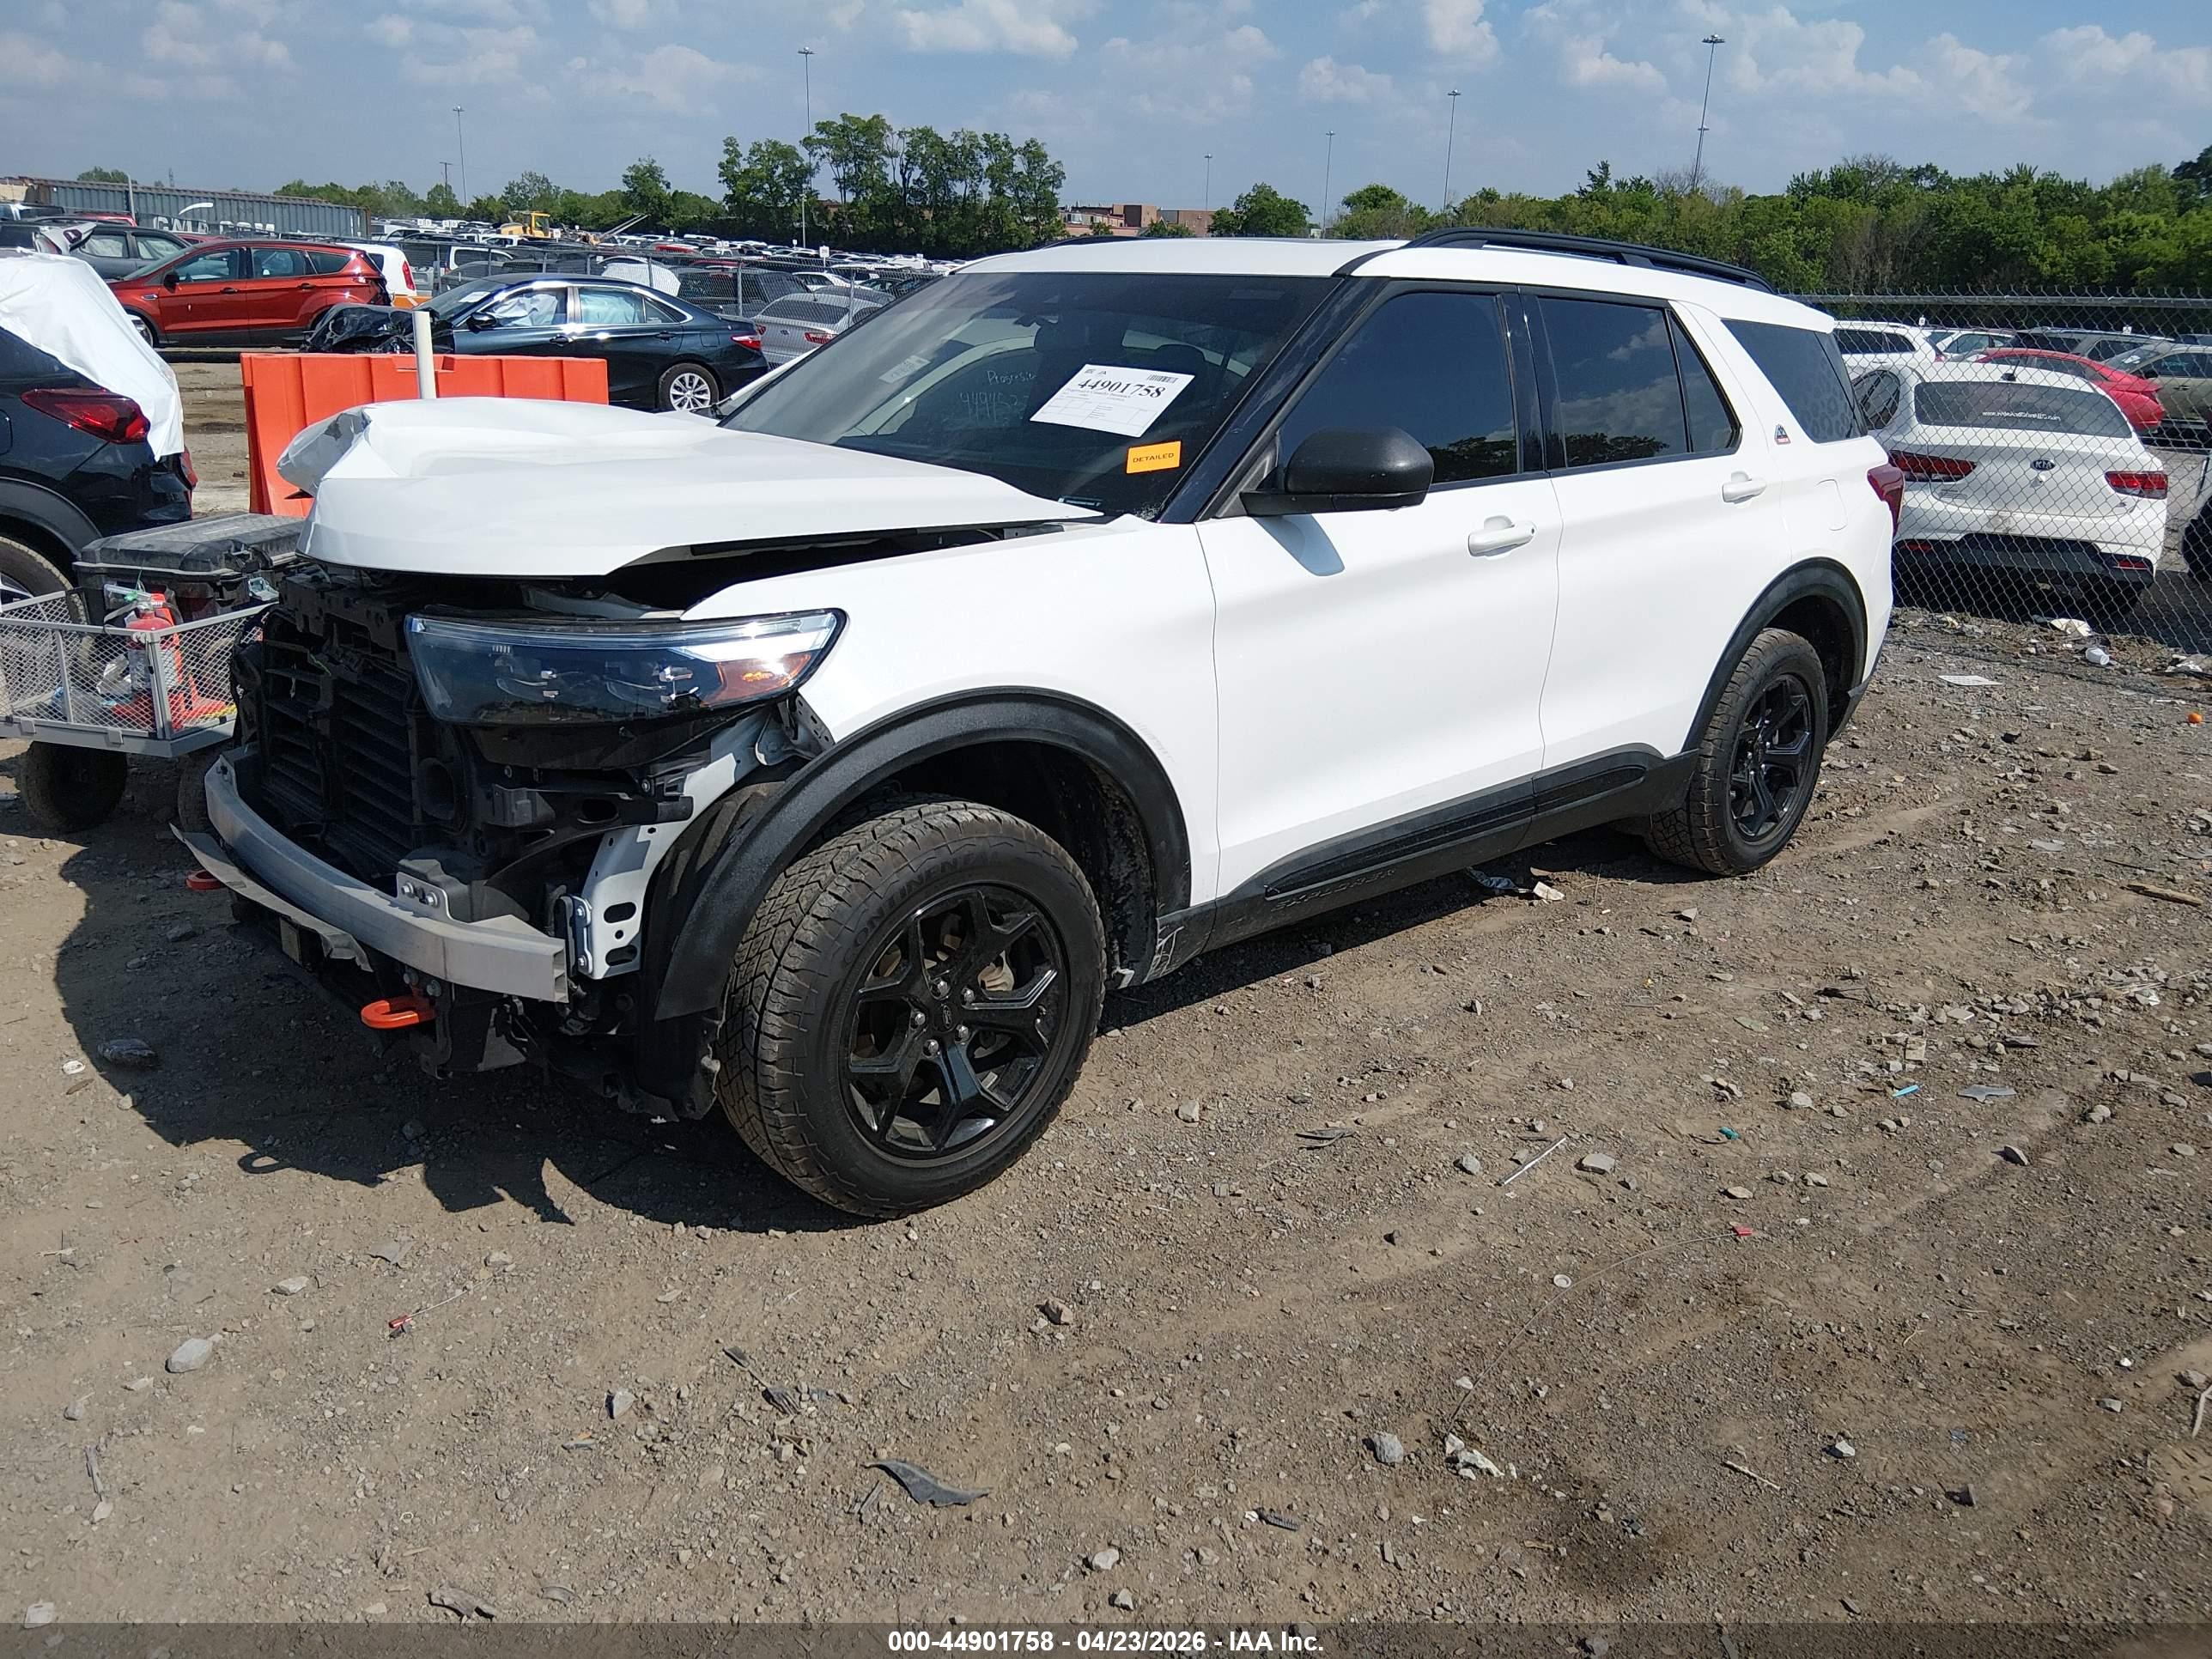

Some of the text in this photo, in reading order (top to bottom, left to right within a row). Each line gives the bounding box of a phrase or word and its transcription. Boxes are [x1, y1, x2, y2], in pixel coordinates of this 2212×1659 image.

[1078, 379, 1166, 398] 44901758
[1133, 453, 1175, 463] DETAILED
[2035, 460, 2052, 470] KIA
[1270, 868, 1395, 913] EXPLORER
